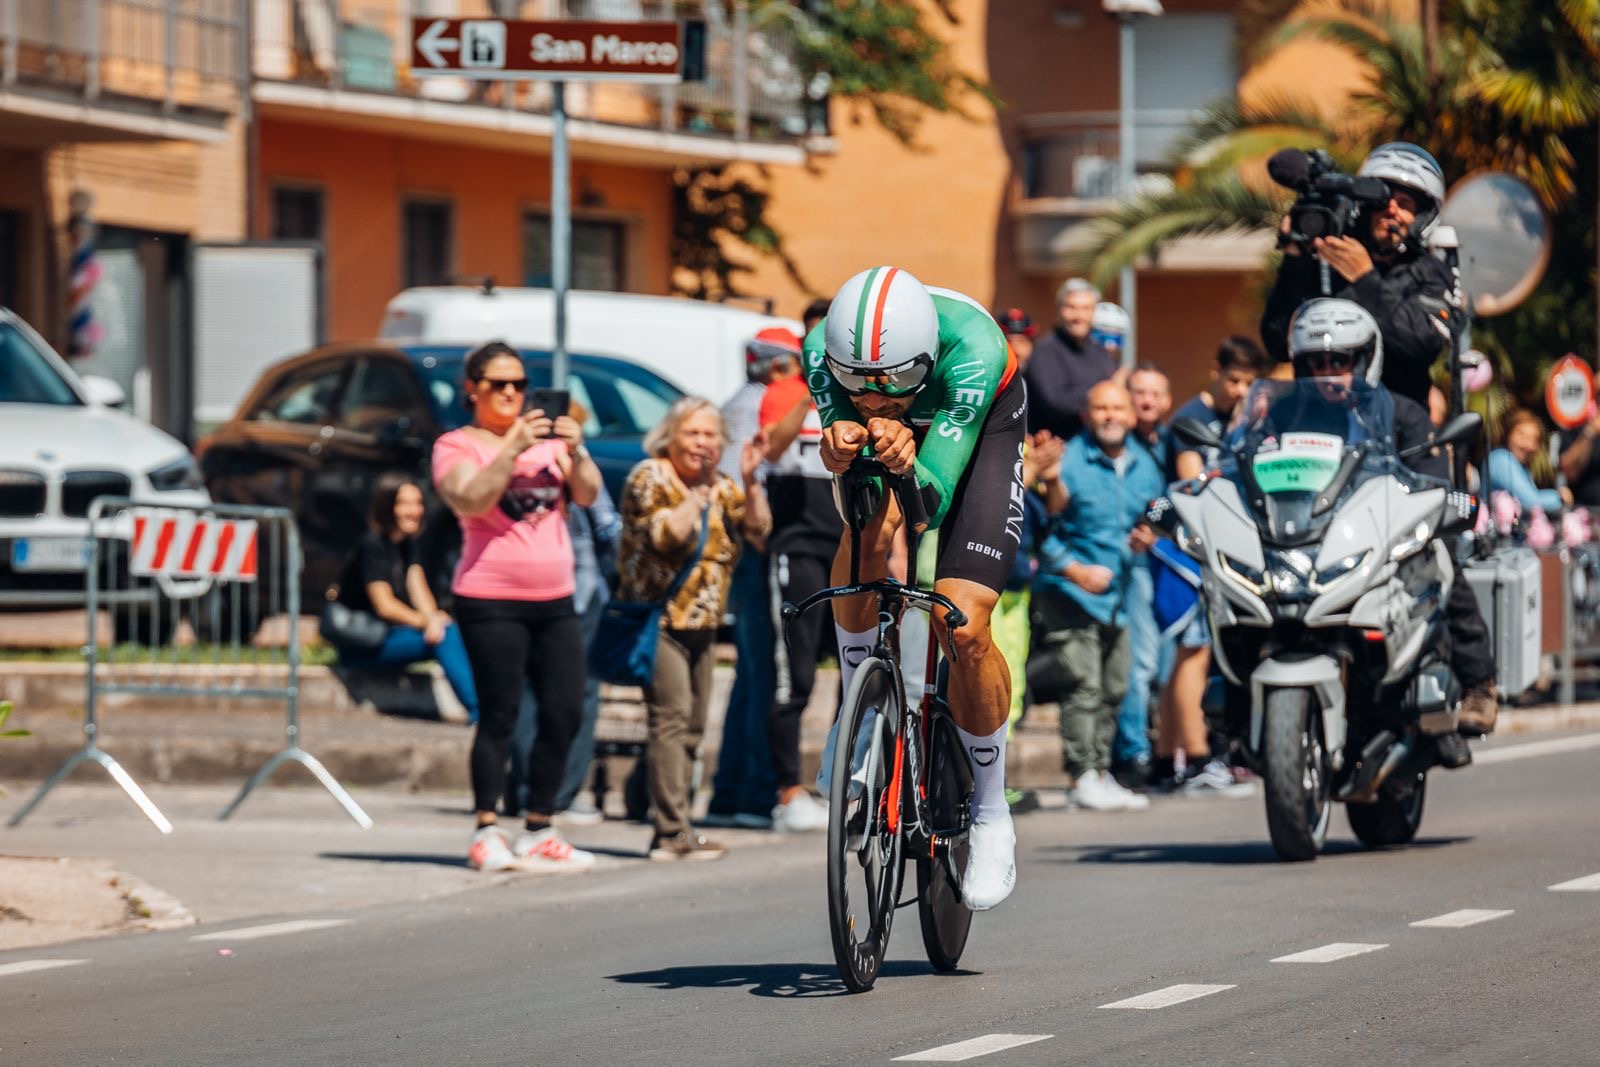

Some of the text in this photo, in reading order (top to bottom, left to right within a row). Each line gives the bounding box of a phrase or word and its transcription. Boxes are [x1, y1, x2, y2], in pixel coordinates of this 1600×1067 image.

[530, 33, 679, 65] San Marco
[938, 358, 987, 442] INEOS
[966, 541, 1002, 560] GOBIK
[834, 586, 862, 595] MUST
[900, 587, 930, 599] MUST
